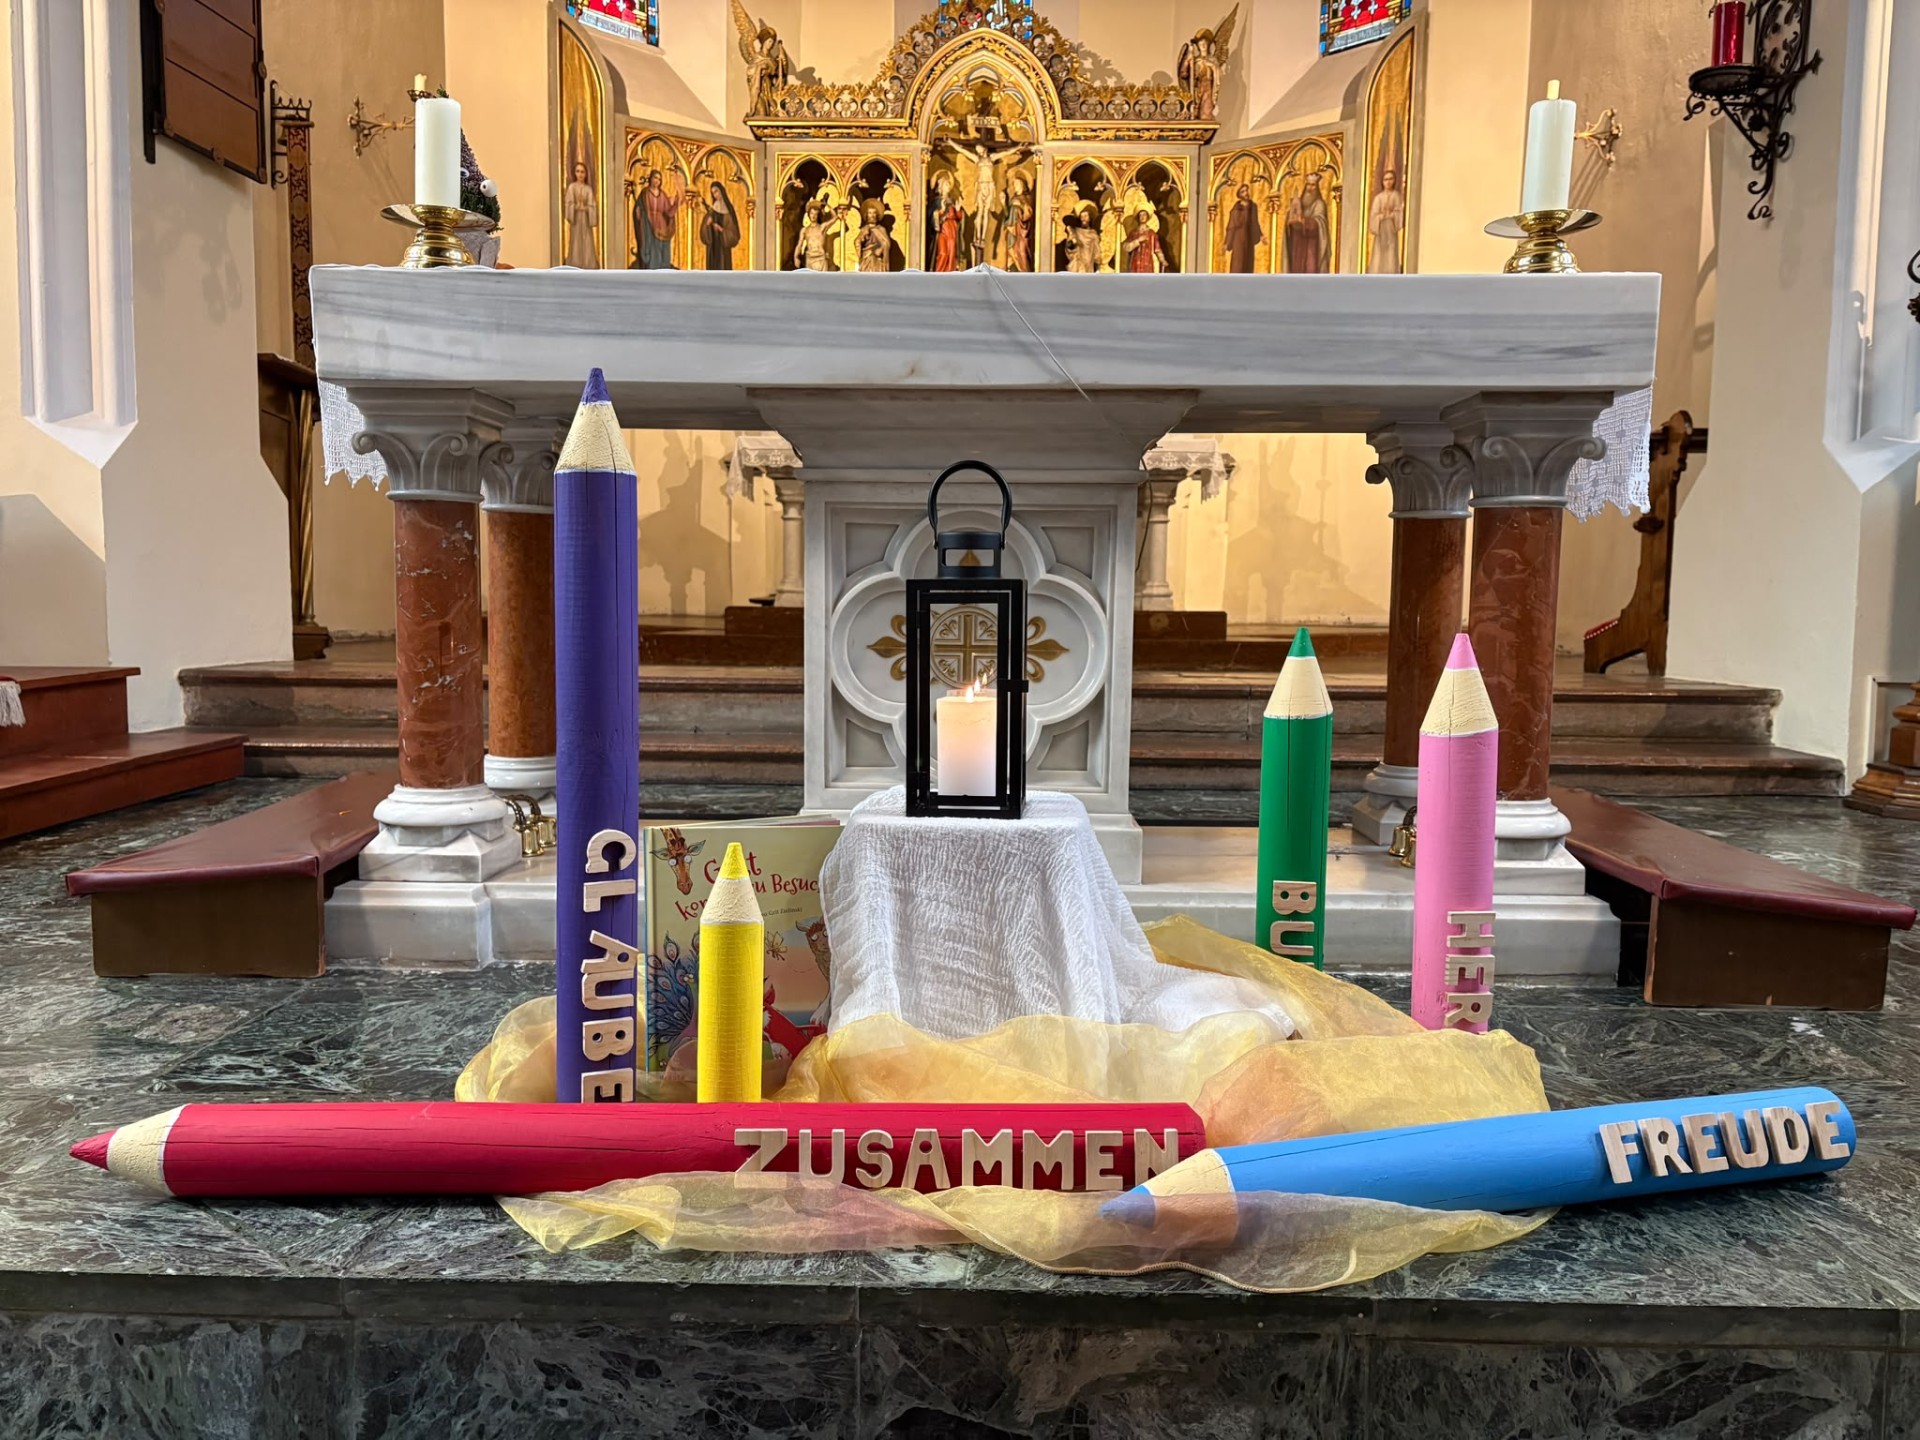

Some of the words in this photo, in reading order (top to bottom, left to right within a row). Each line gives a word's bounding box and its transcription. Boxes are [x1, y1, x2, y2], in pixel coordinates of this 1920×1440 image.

[704, 851, 762, 885] Gt
[770, 873, 820, 895] Besuc
[581, 829, 640, 1103] GLAUBE
[1270, 880, 1318, 969] BU
[1444, 911, 1496, 1035] HER
[734, 1128, 1179, 1190] ZUSAMMEN
[1599, 1101, 1851, 1185] FREUDE
